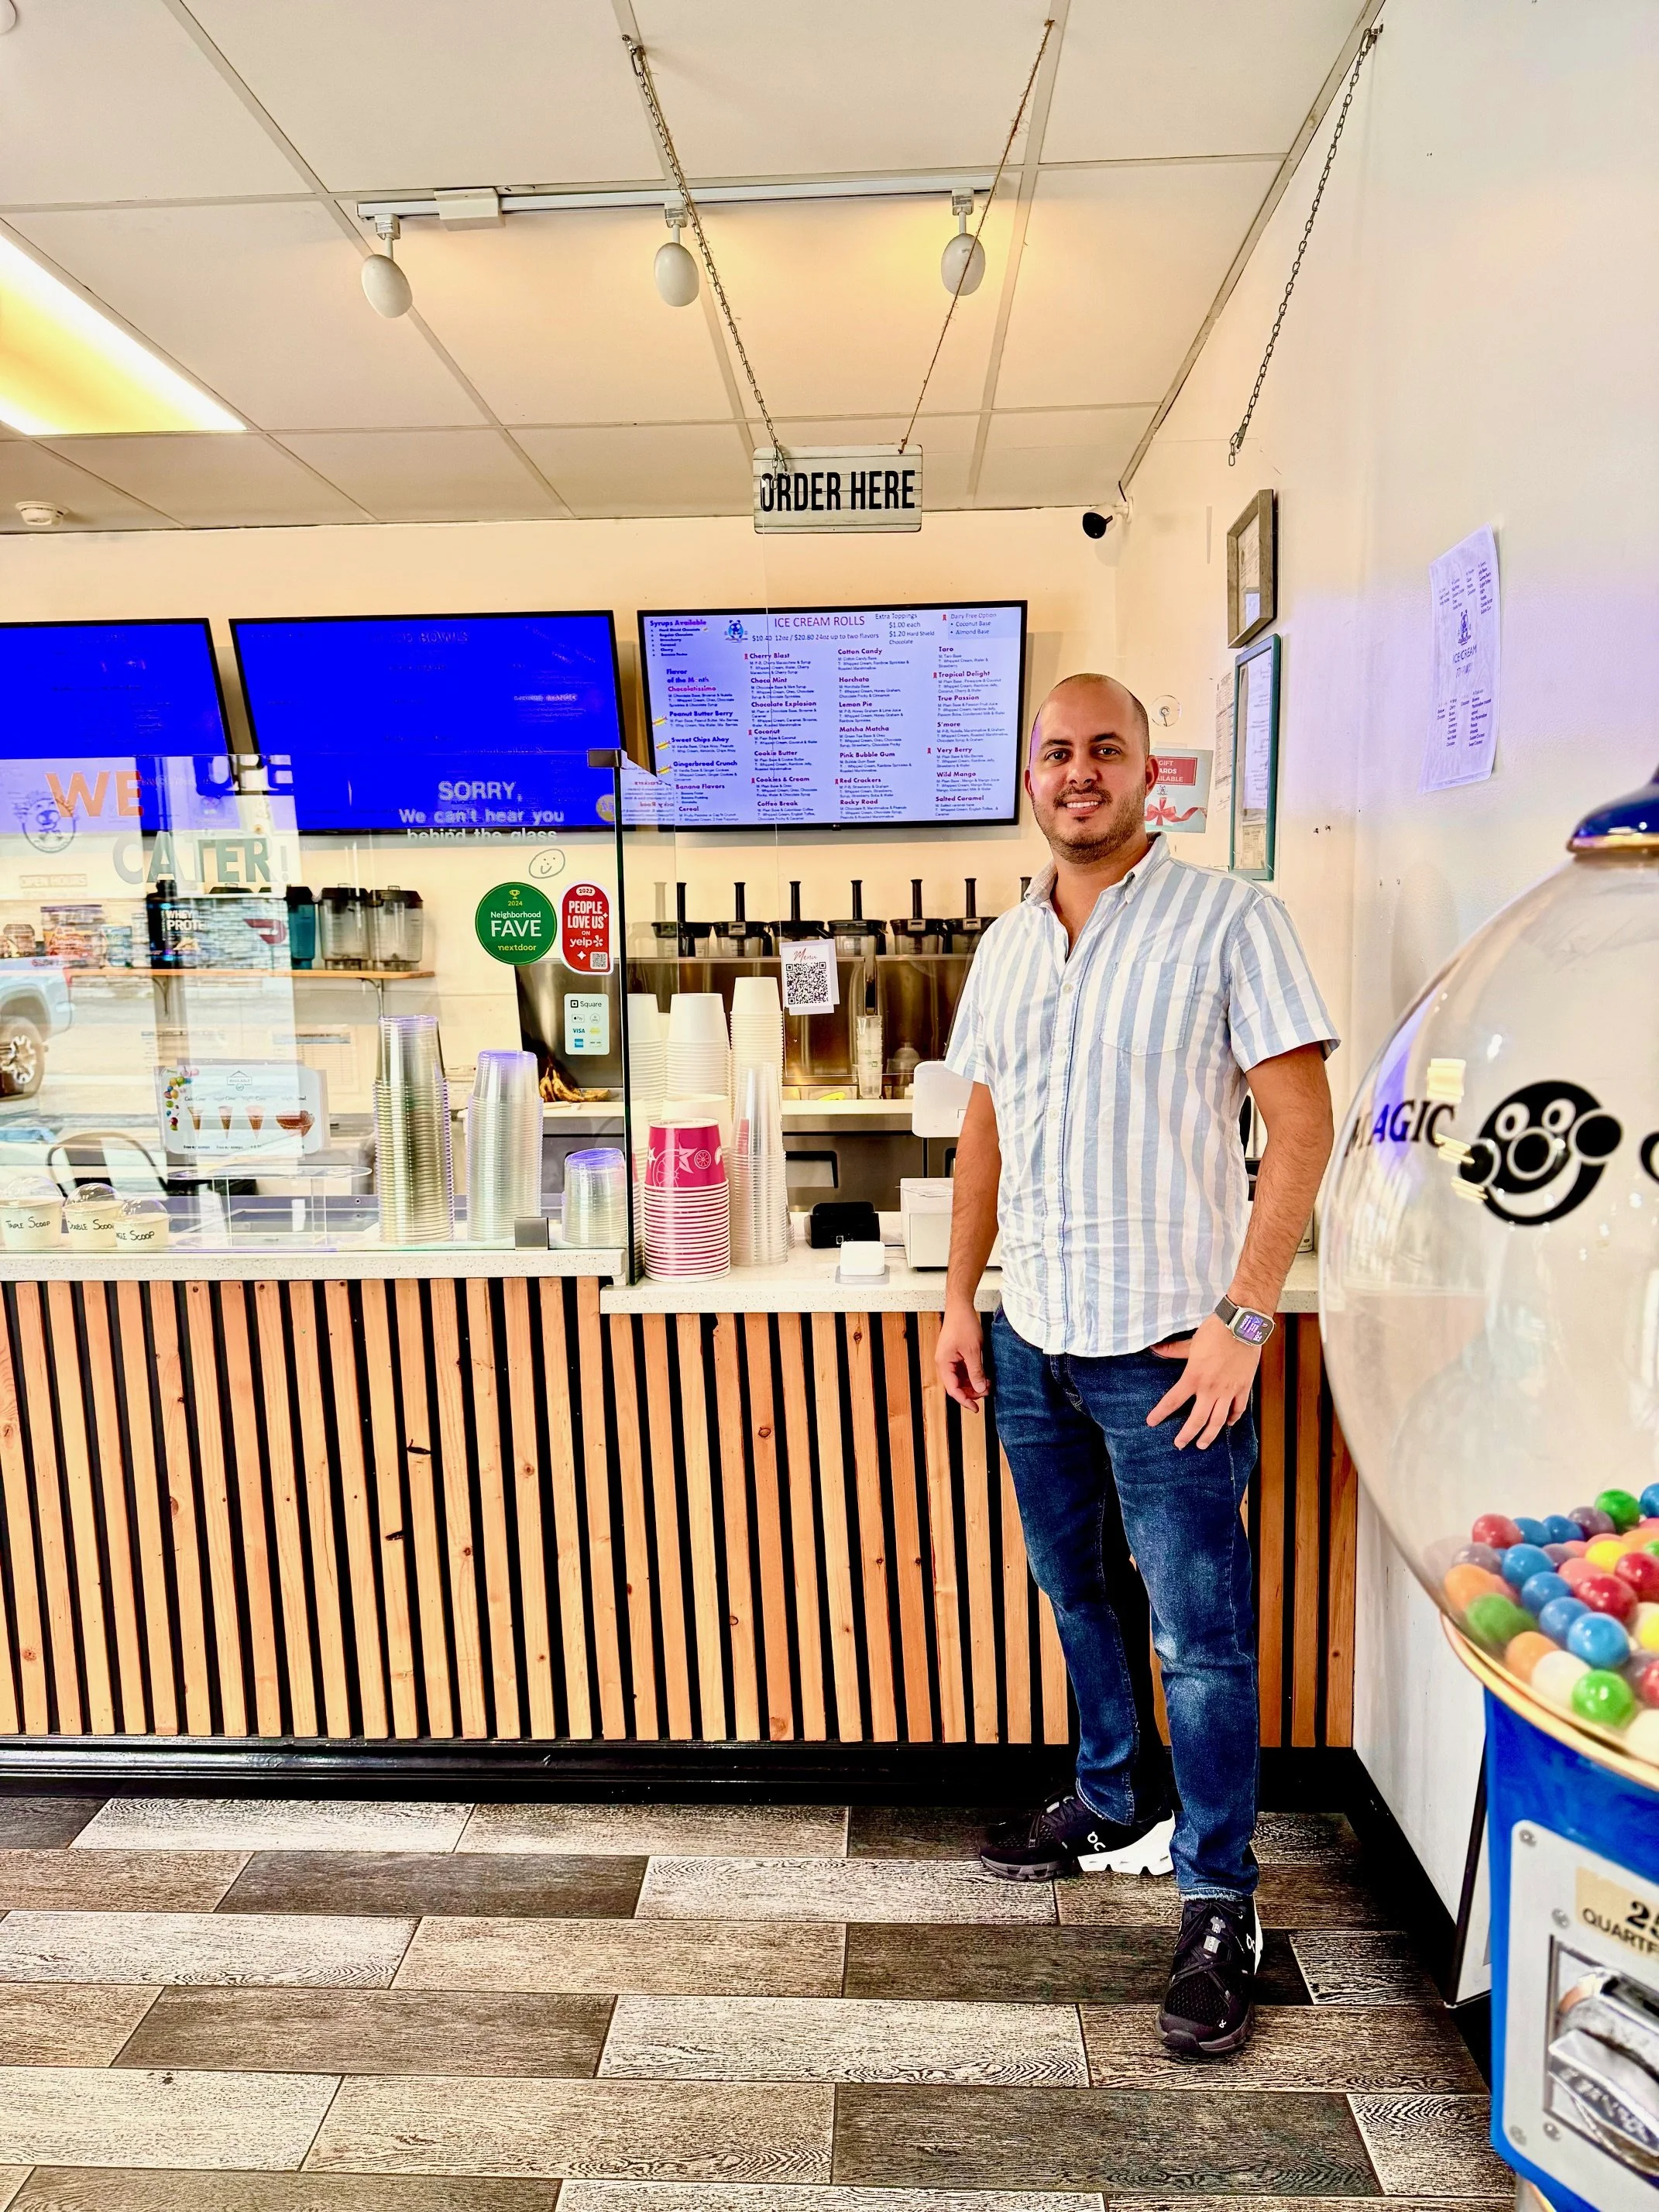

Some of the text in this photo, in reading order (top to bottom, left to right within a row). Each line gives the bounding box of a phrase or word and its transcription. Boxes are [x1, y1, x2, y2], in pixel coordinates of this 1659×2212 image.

[761, 470, 915, 512] ORDER HERE
[775, 616, 865, 627] ICE CREAM ROLLS
[45, 771, 144, 818] WE
[438, 781, 522, 802] SORRY,
[399, 808, 564, 826] We can't hear you
[407, 828, 557, 844] behind the glass
[569, 901, 603, 914] PEOPLE
[491, 920, 542, 937] FAVE
[568, 915, 604, 929] LOVE US
[570, 938, 593, 948] yelp
[793, 948, 817, 963] Menu
[1583, 1908, 1659, 1953] QUARTE
